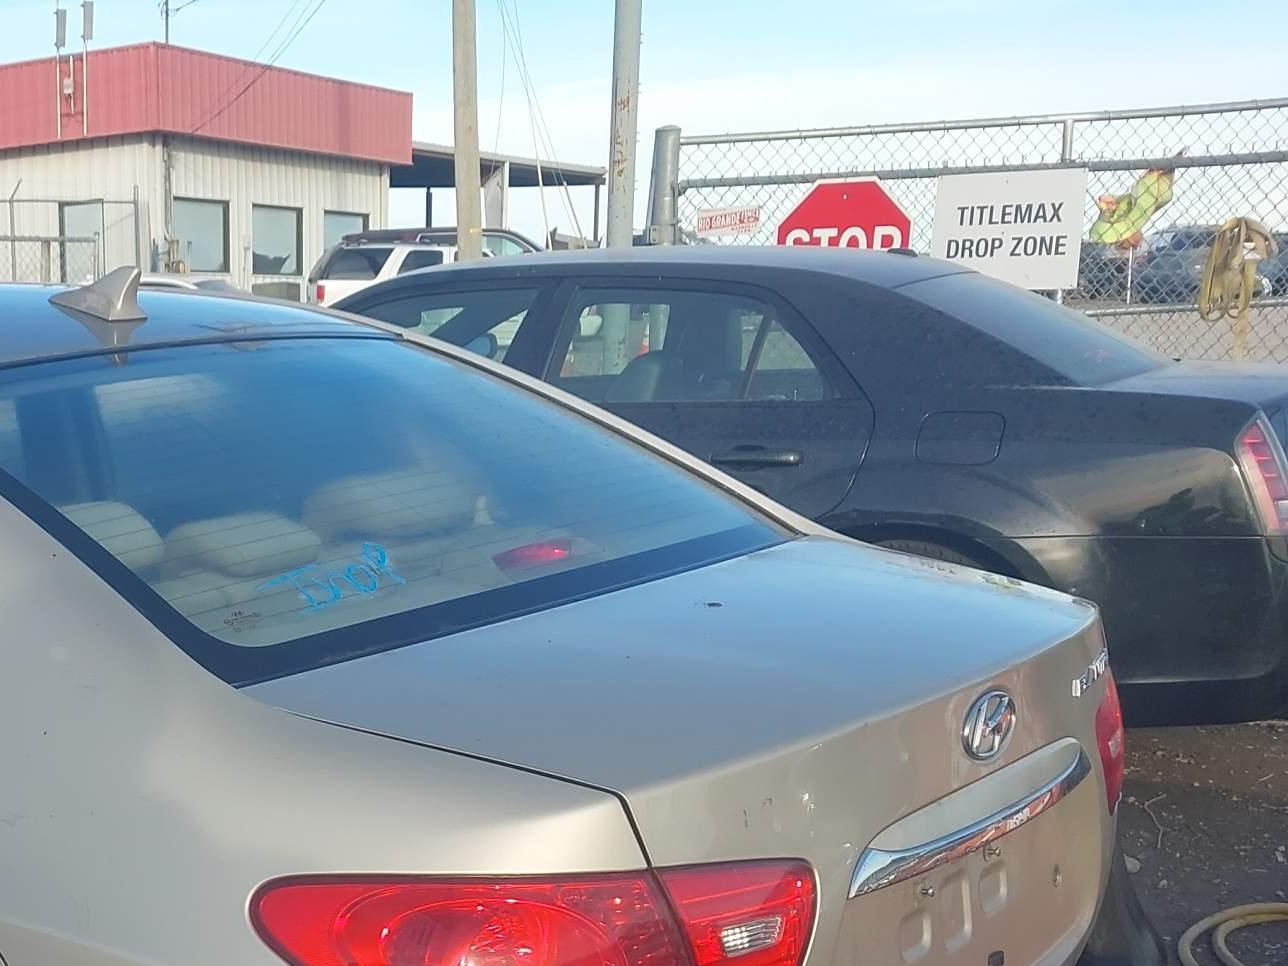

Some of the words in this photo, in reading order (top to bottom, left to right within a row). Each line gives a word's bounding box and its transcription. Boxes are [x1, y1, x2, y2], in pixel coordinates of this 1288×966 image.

[697, 217, 711, 231] RIO
[957, 202, 1064, 226] TITLEMAX
[946, 238, 1003, 258] DROP
[1009, 235, 1067, 257] ZONE
